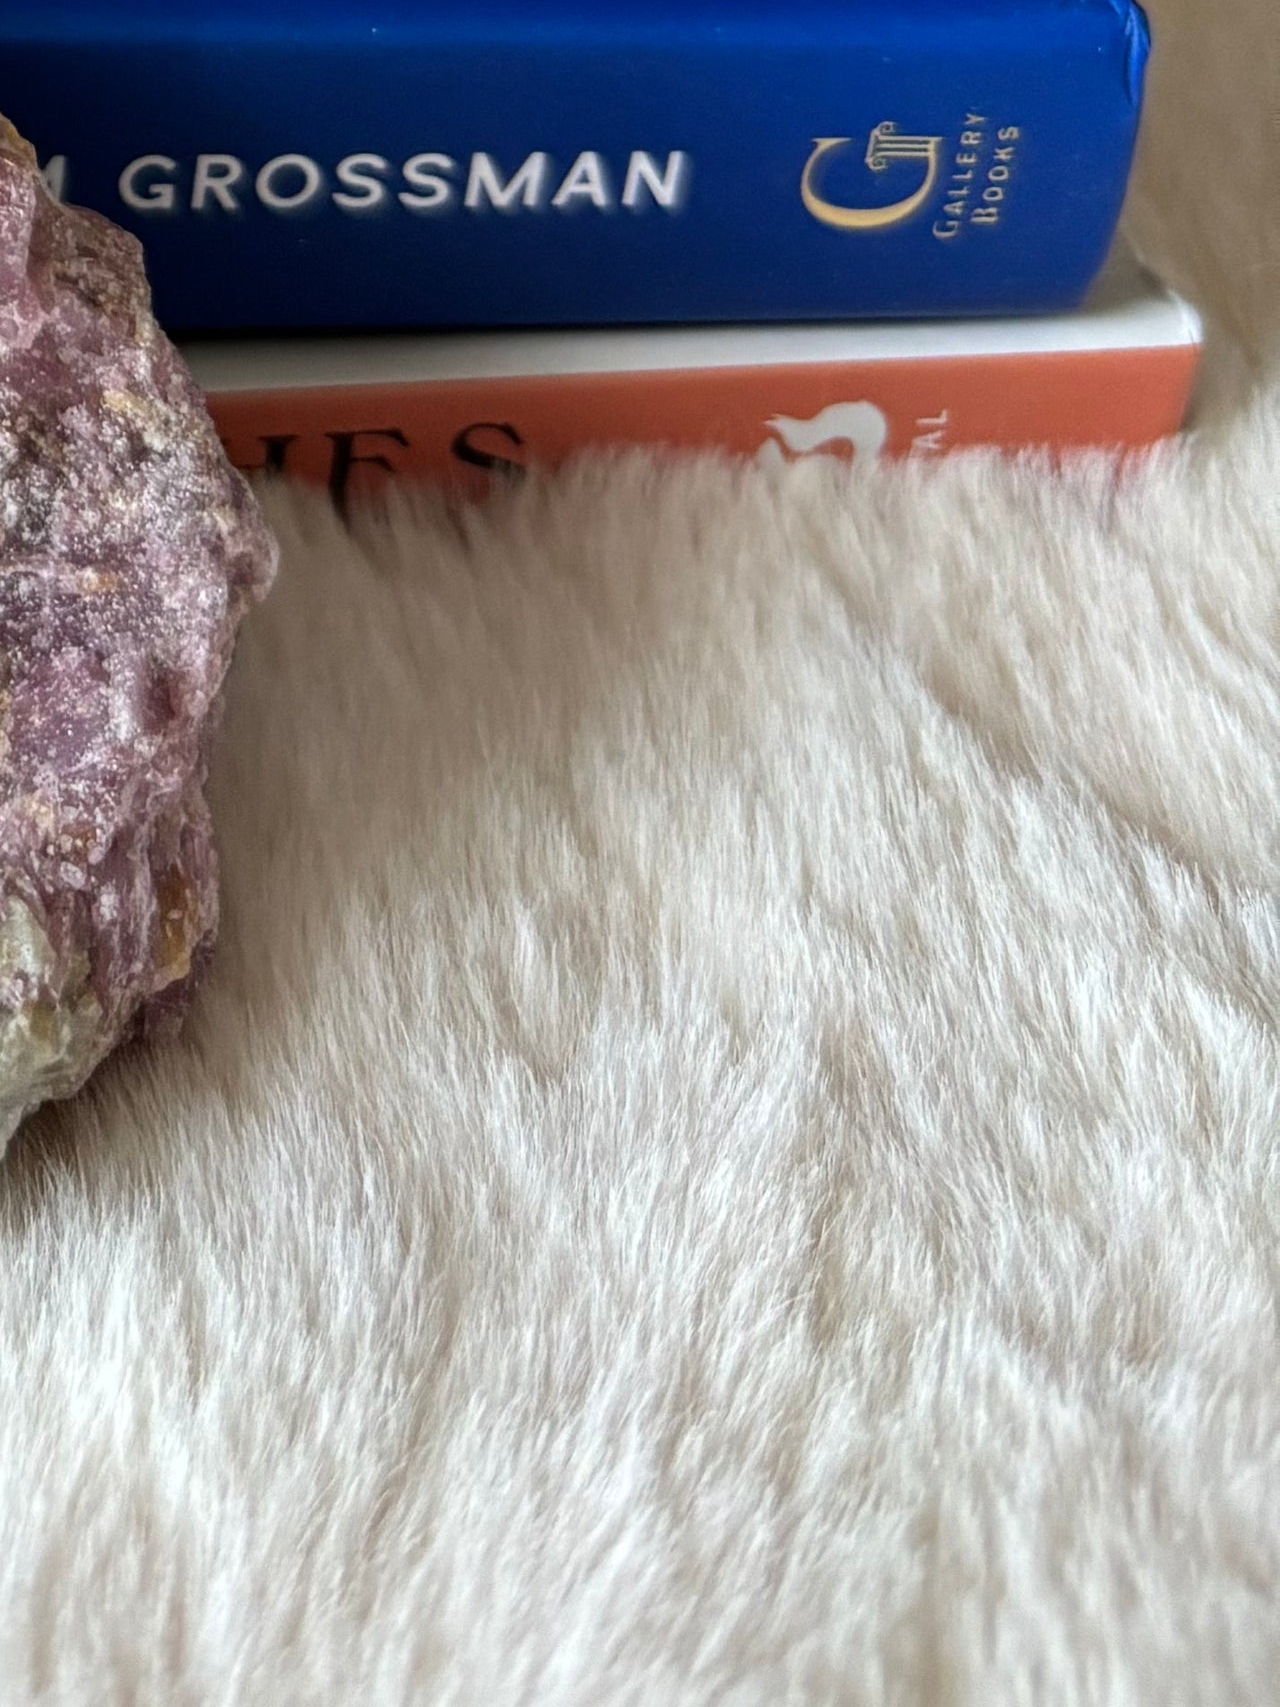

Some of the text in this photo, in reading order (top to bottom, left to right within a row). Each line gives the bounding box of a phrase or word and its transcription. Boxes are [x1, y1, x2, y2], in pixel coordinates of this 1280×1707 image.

[117, 149, 688, 211] GROSSMAN
[932, 112, 987, 239] GALLERY
[969, 124, 1020, 224] BOOKS
